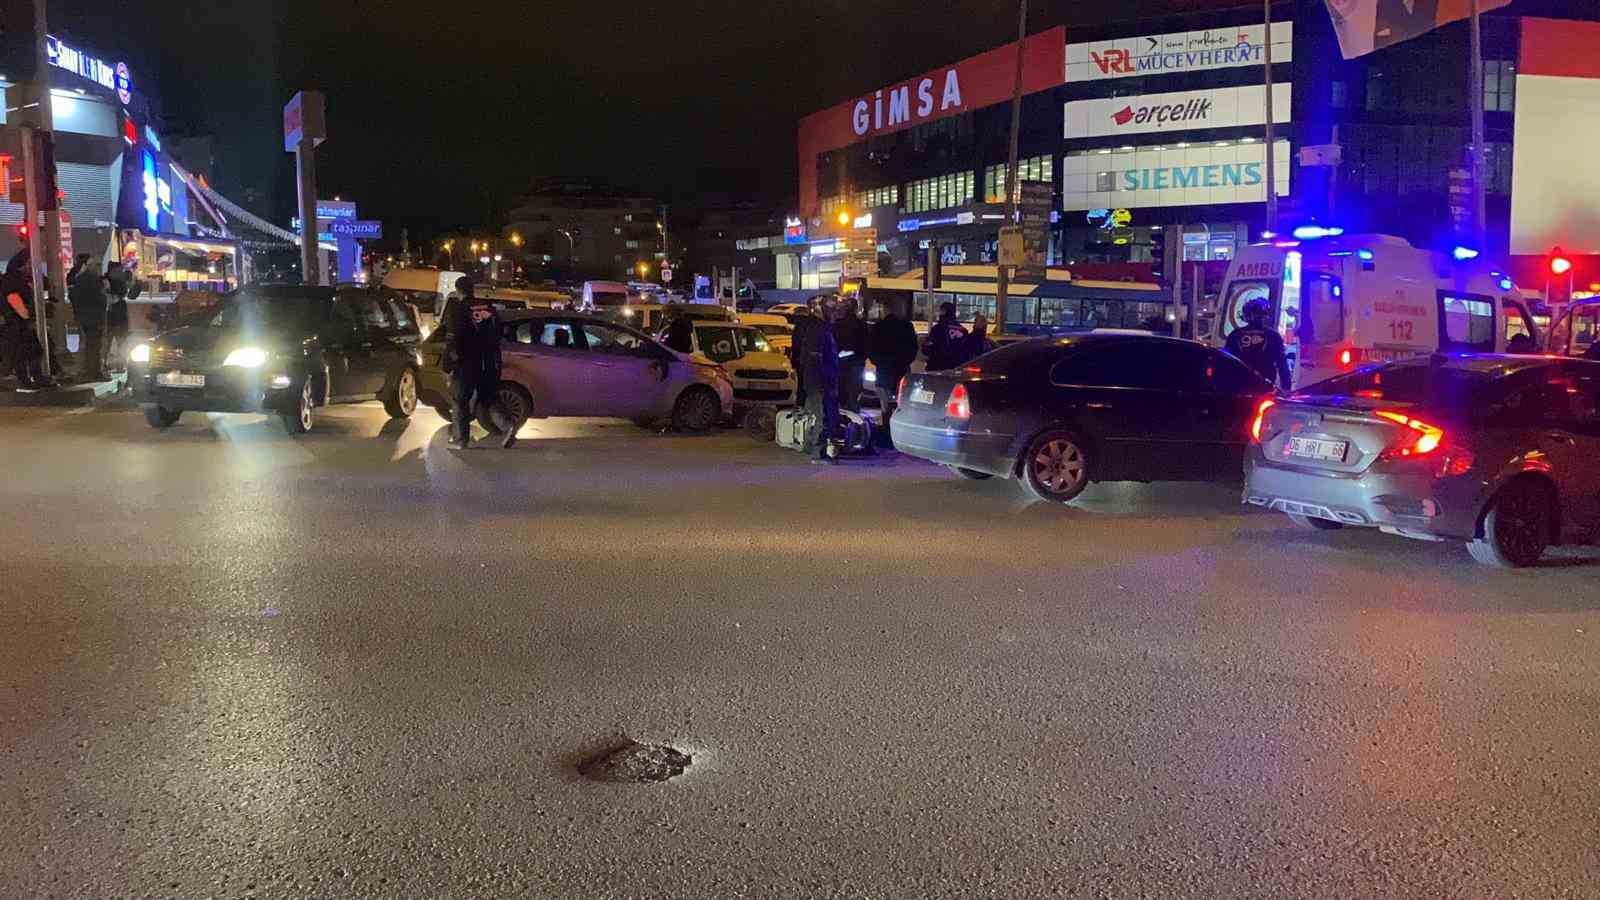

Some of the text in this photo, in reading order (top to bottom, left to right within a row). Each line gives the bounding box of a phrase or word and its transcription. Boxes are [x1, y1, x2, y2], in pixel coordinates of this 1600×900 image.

[1091, 42, 1264, 75] VRL MÜCEVHERAT
[853, 69, 961, 136] GİMSA
[1134, 98, 1213, 127] arçelik
[1124, 161, 1262, 191] SIEMENS
[1389, 320, 1413, 340] 112
